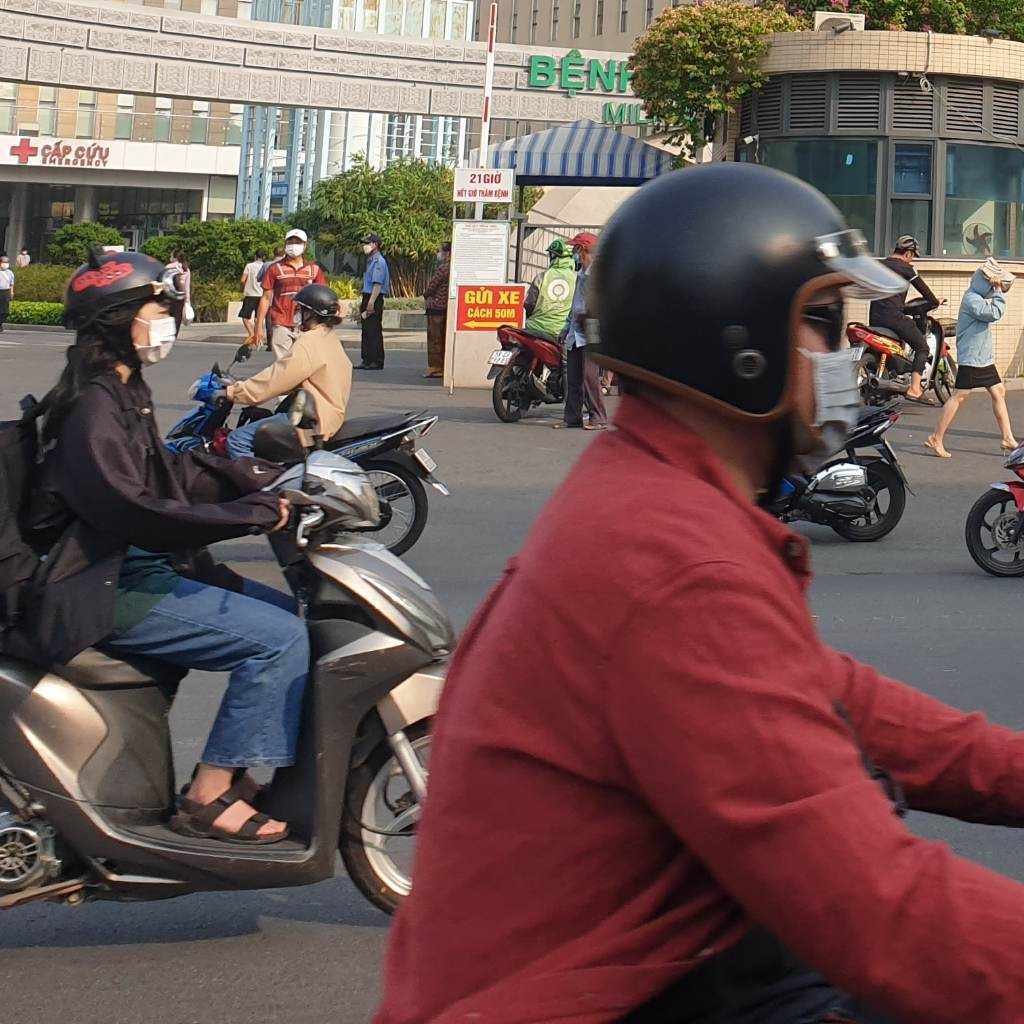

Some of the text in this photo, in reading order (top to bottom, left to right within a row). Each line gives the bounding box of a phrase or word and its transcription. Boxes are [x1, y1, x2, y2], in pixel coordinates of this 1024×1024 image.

[41, 140, 72, 159] CẤP
[498, 290, 520, 305] XE
[467, 306, 516, 319] CÁCH 50M
